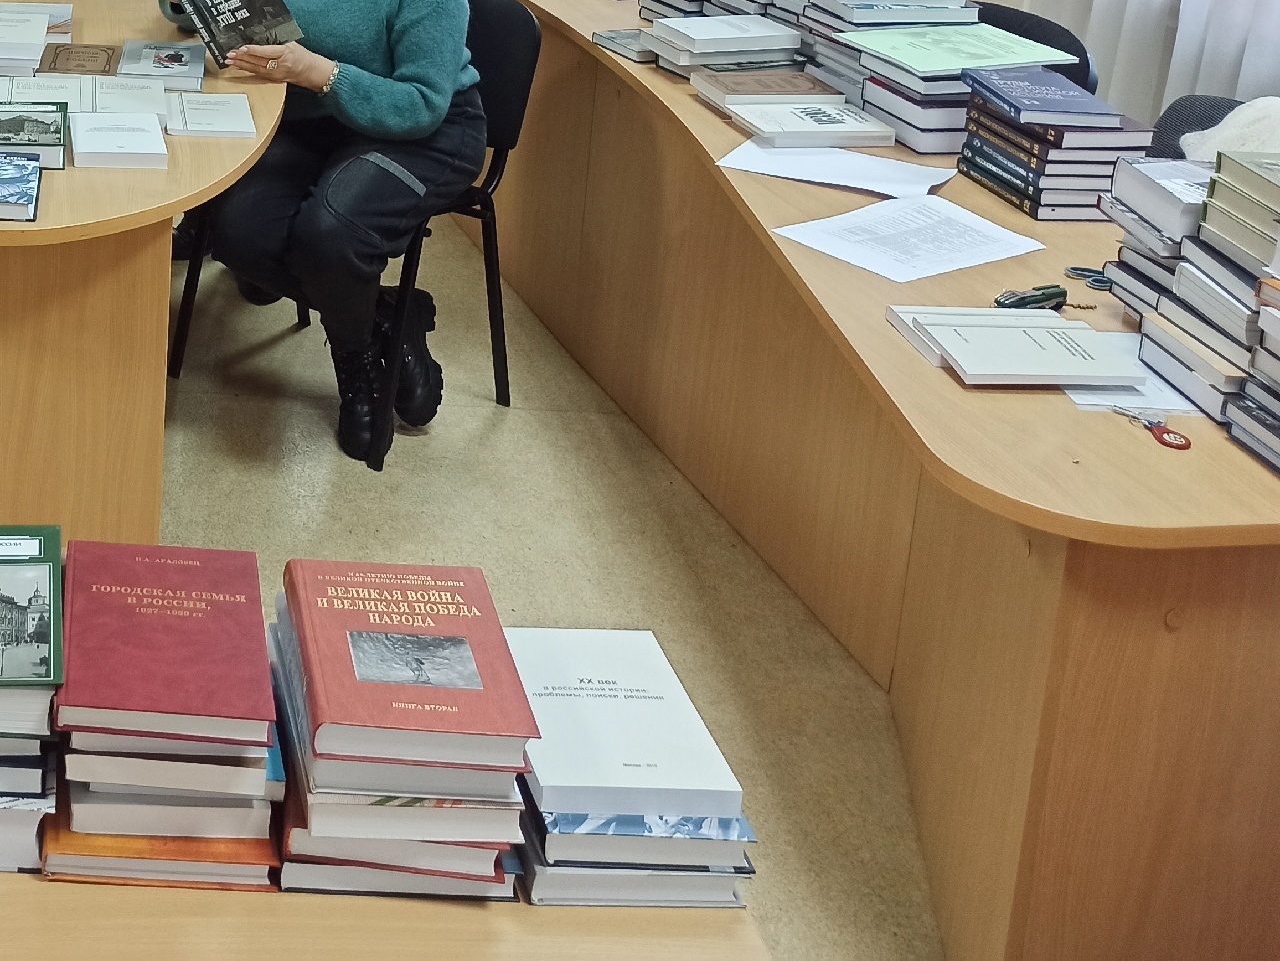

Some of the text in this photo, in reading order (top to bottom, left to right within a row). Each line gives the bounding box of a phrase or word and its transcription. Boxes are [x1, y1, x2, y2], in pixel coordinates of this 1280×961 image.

[91, 584, 247, 603] ГОРОДСКАЯ СЕМЬЯ
[326, 586, 465, 603] ВЕЛИКАЯ ВОЙНА
[127, 596, 211, 611] В РОССИИ,
[316, 597, 482, 617] И ВЕЛИКАЯ ПОБЕДА
[368, 613, 436, 627] НАРОДА
[392, 701, 459, 712] КНИГА ВТОРАЯ
